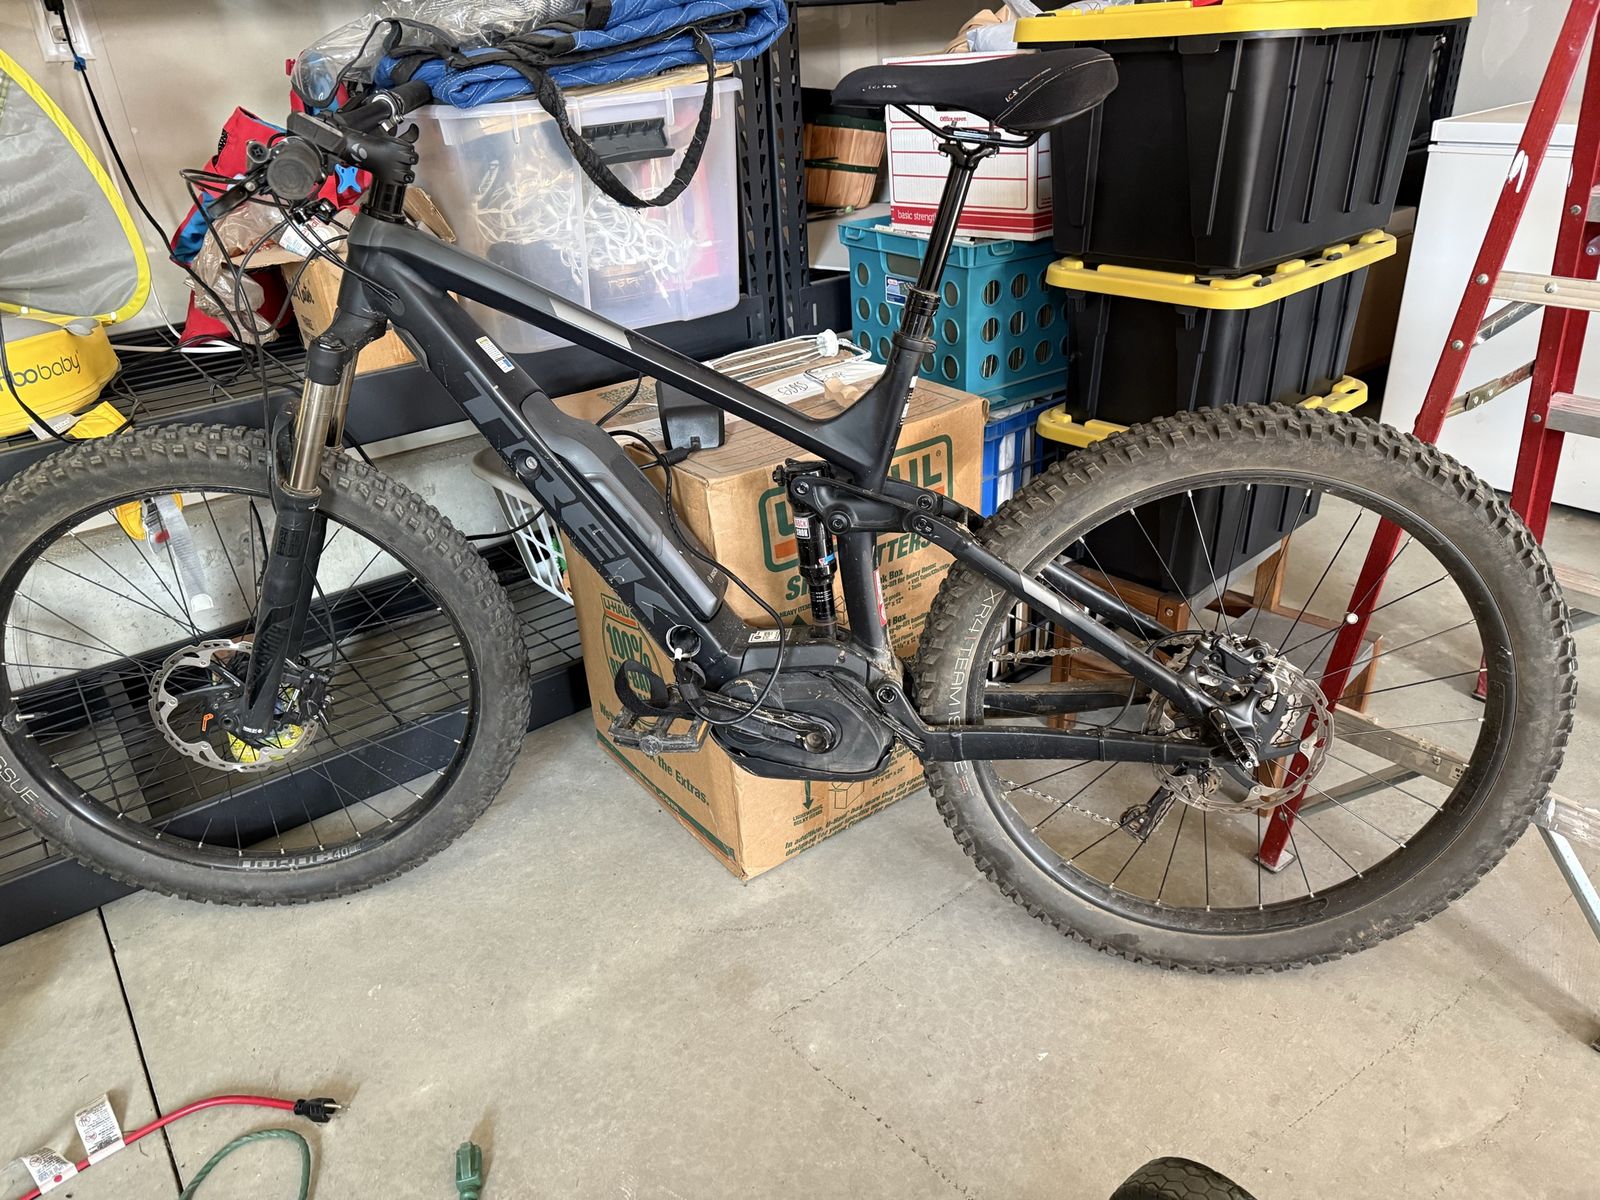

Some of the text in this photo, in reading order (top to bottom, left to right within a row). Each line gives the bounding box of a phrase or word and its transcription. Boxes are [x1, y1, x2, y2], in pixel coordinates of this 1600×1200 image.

[897, 208, 913, 219] basic
[463, 371, 681, 625] TREK
[889, 569, 903, 580] Box
[779, 609, 797, 617] HEAVY
[892, 613, 906, 625] Box
[968, 589, 1002, 632] XR4
[606, 623, 652, 673] 100%
[948, 643, 974, 706] TEAM
[657, 755, 673, 776] the
[675, 769, 710, 806] Extras.
